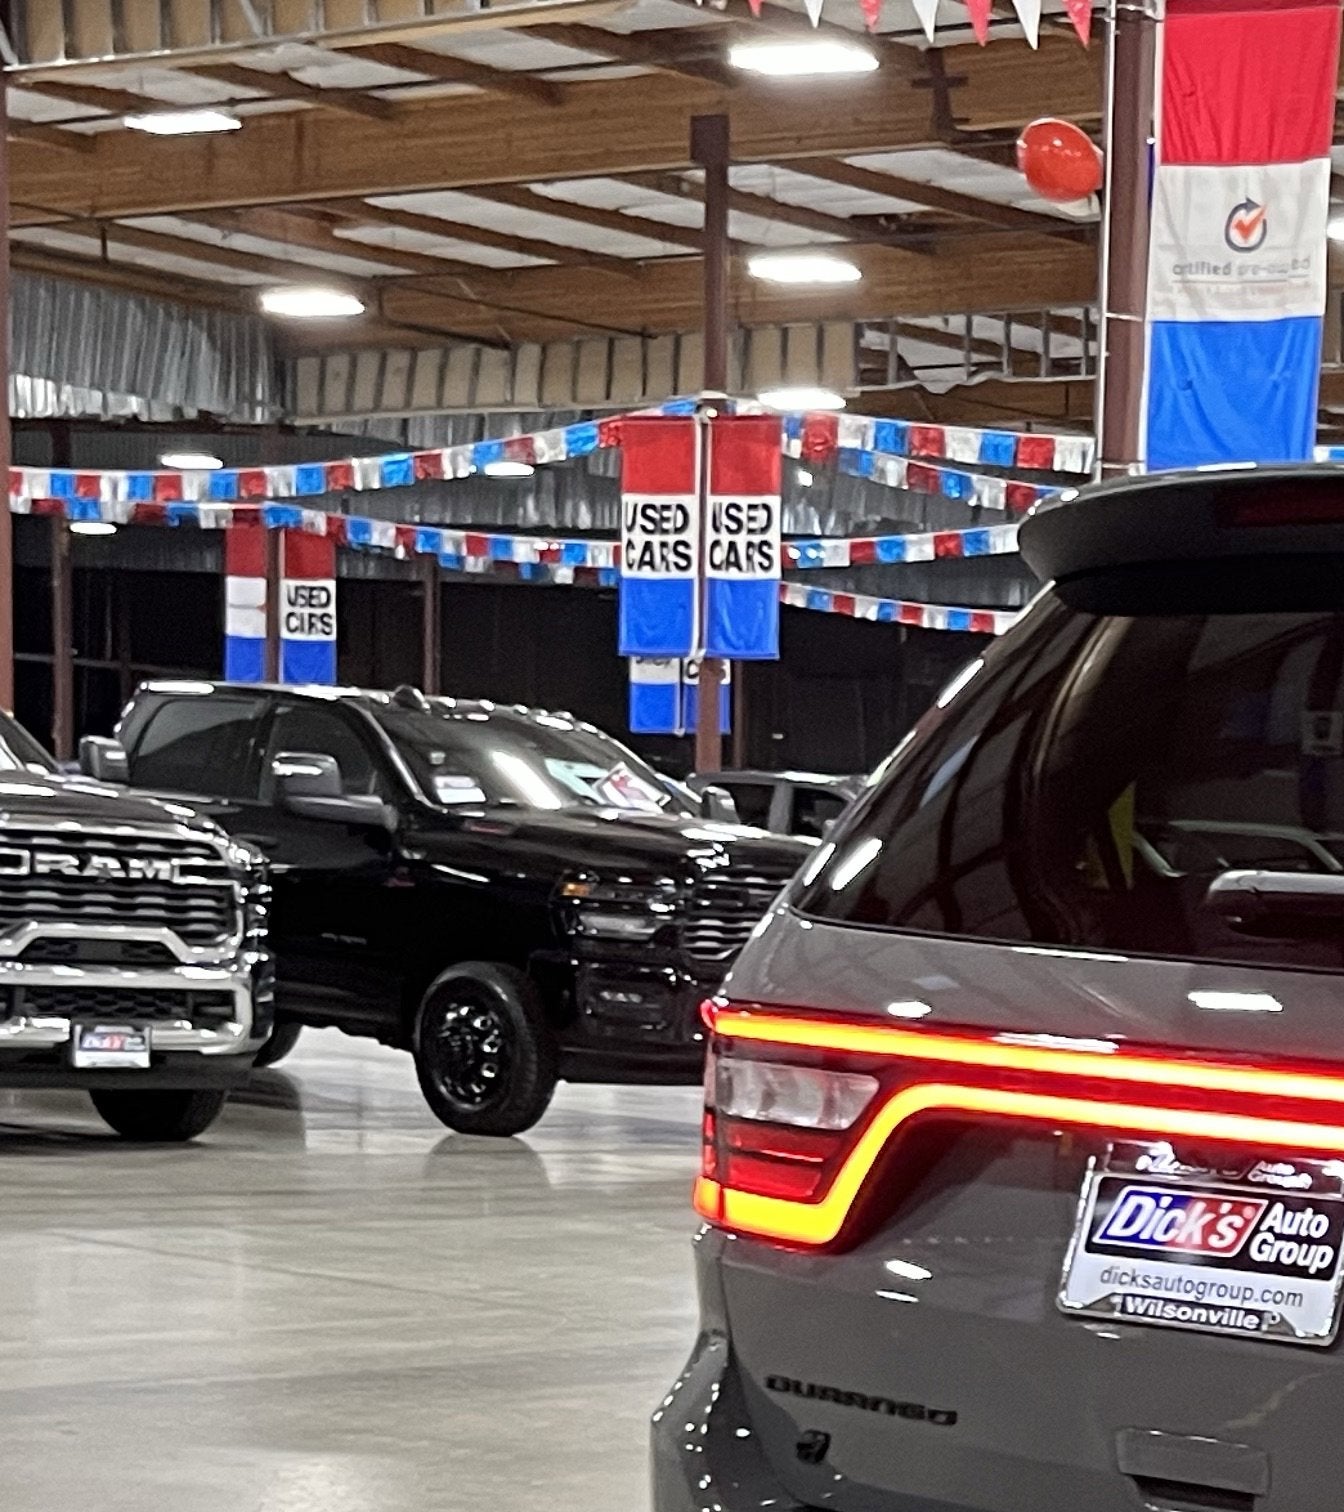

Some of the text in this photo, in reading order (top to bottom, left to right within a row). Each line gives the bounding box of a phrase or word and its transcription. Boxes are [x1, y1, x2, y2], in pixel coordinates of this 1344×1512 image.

[624, 502, 690, 535] USED
[711, 502, 774, 535] USED
[624, 539, 693, 572] CARS
[709, 540, 775, 572] CARS
[286, 585, 332, 608] USED
[35, 852, 172, 880] RAM
[1106, 1195, 1245, 1249] Dick's
[1259, 1202, 1331, 1239] Auto
[1249, 1232, 1335, 1274] Group
[1100, 1266, 1305, 1308] dicksautogroup.com
[1124, 1295, 1261, 1331] Wilsonville
